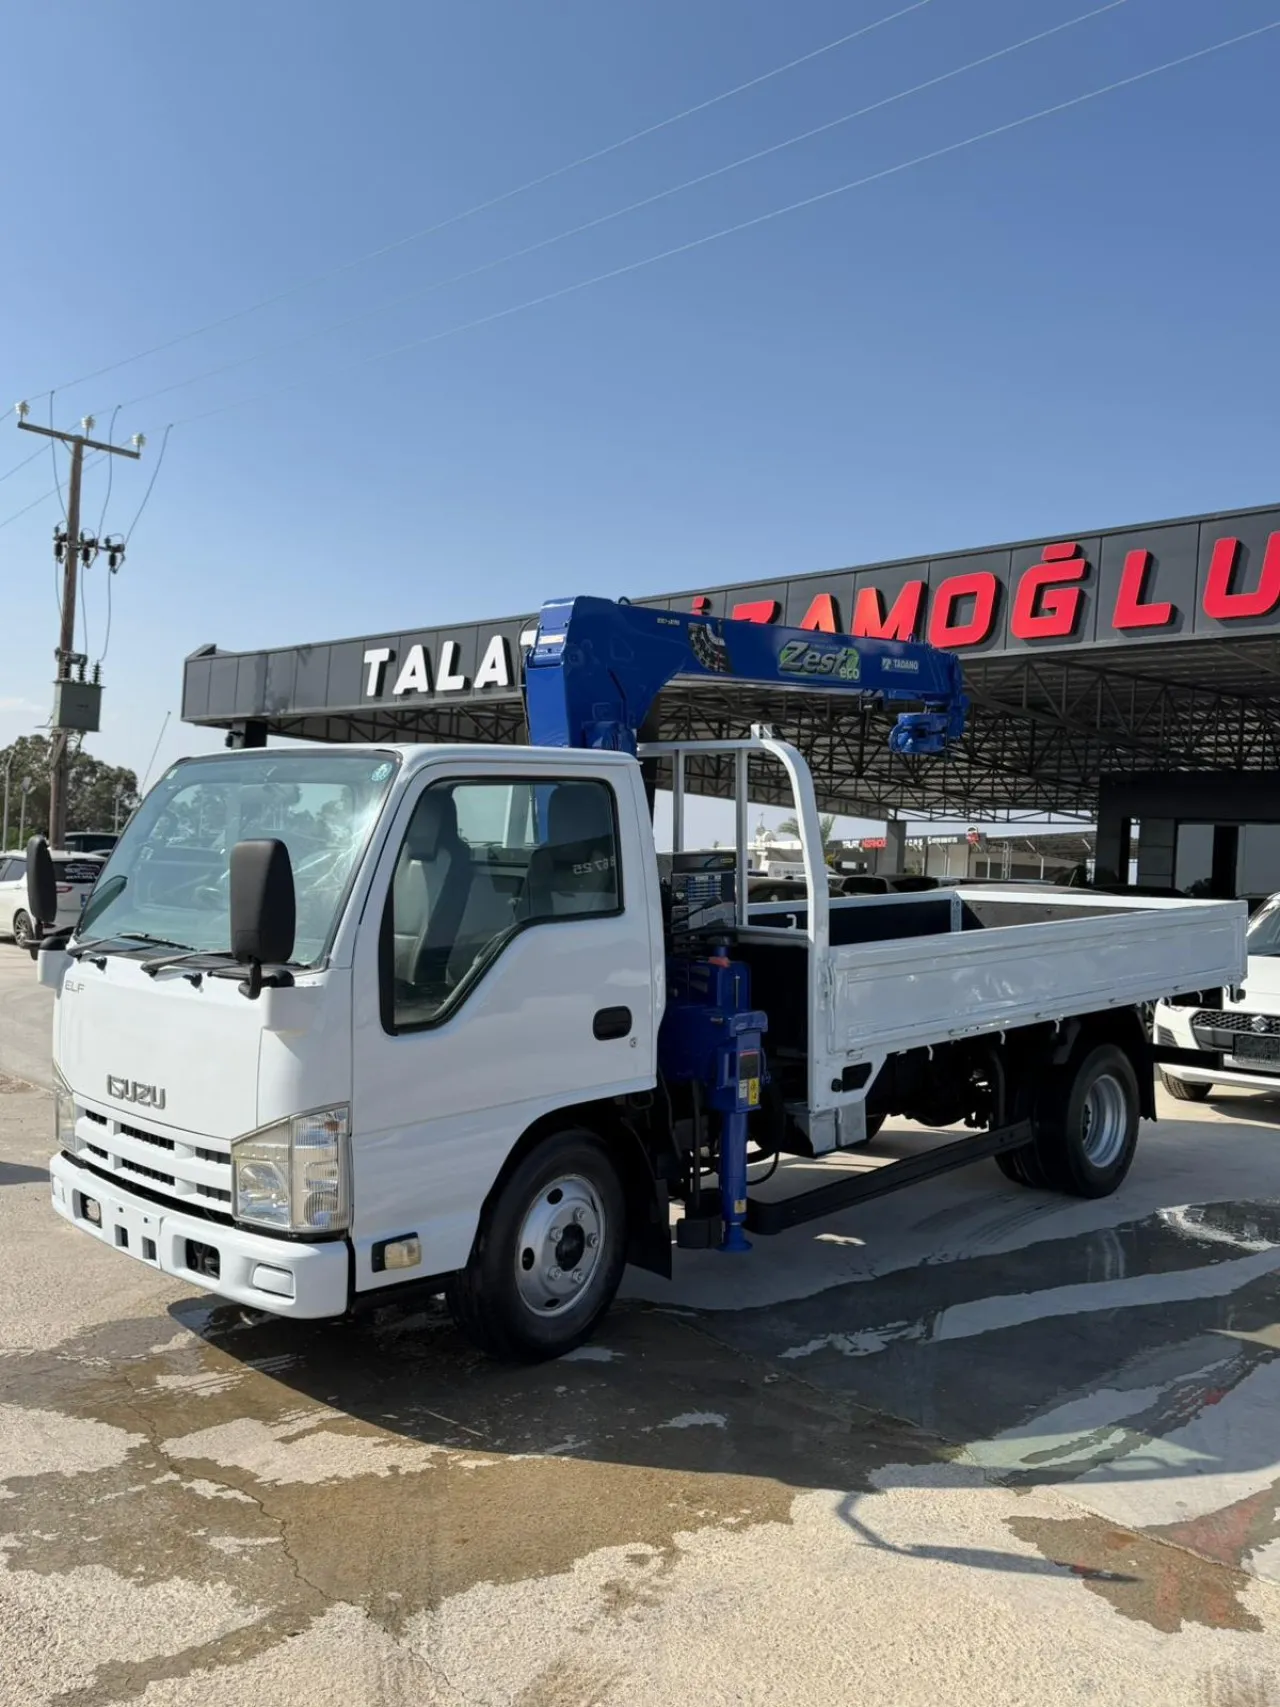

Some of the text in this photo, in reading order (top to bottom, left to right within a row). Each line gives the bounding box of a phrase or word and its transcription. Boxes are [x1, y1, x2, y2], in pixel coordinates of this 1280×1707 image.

[690, 530, 1280, 649] AMOĞLU
[779, 640, 848, 675] Zest
[893, 658, 919, 671] TADANO
[840, 667, 860, 680] eco
[65, 980, 85, 993] ELF
[107, 1074, 166, 1110] ISUZU
